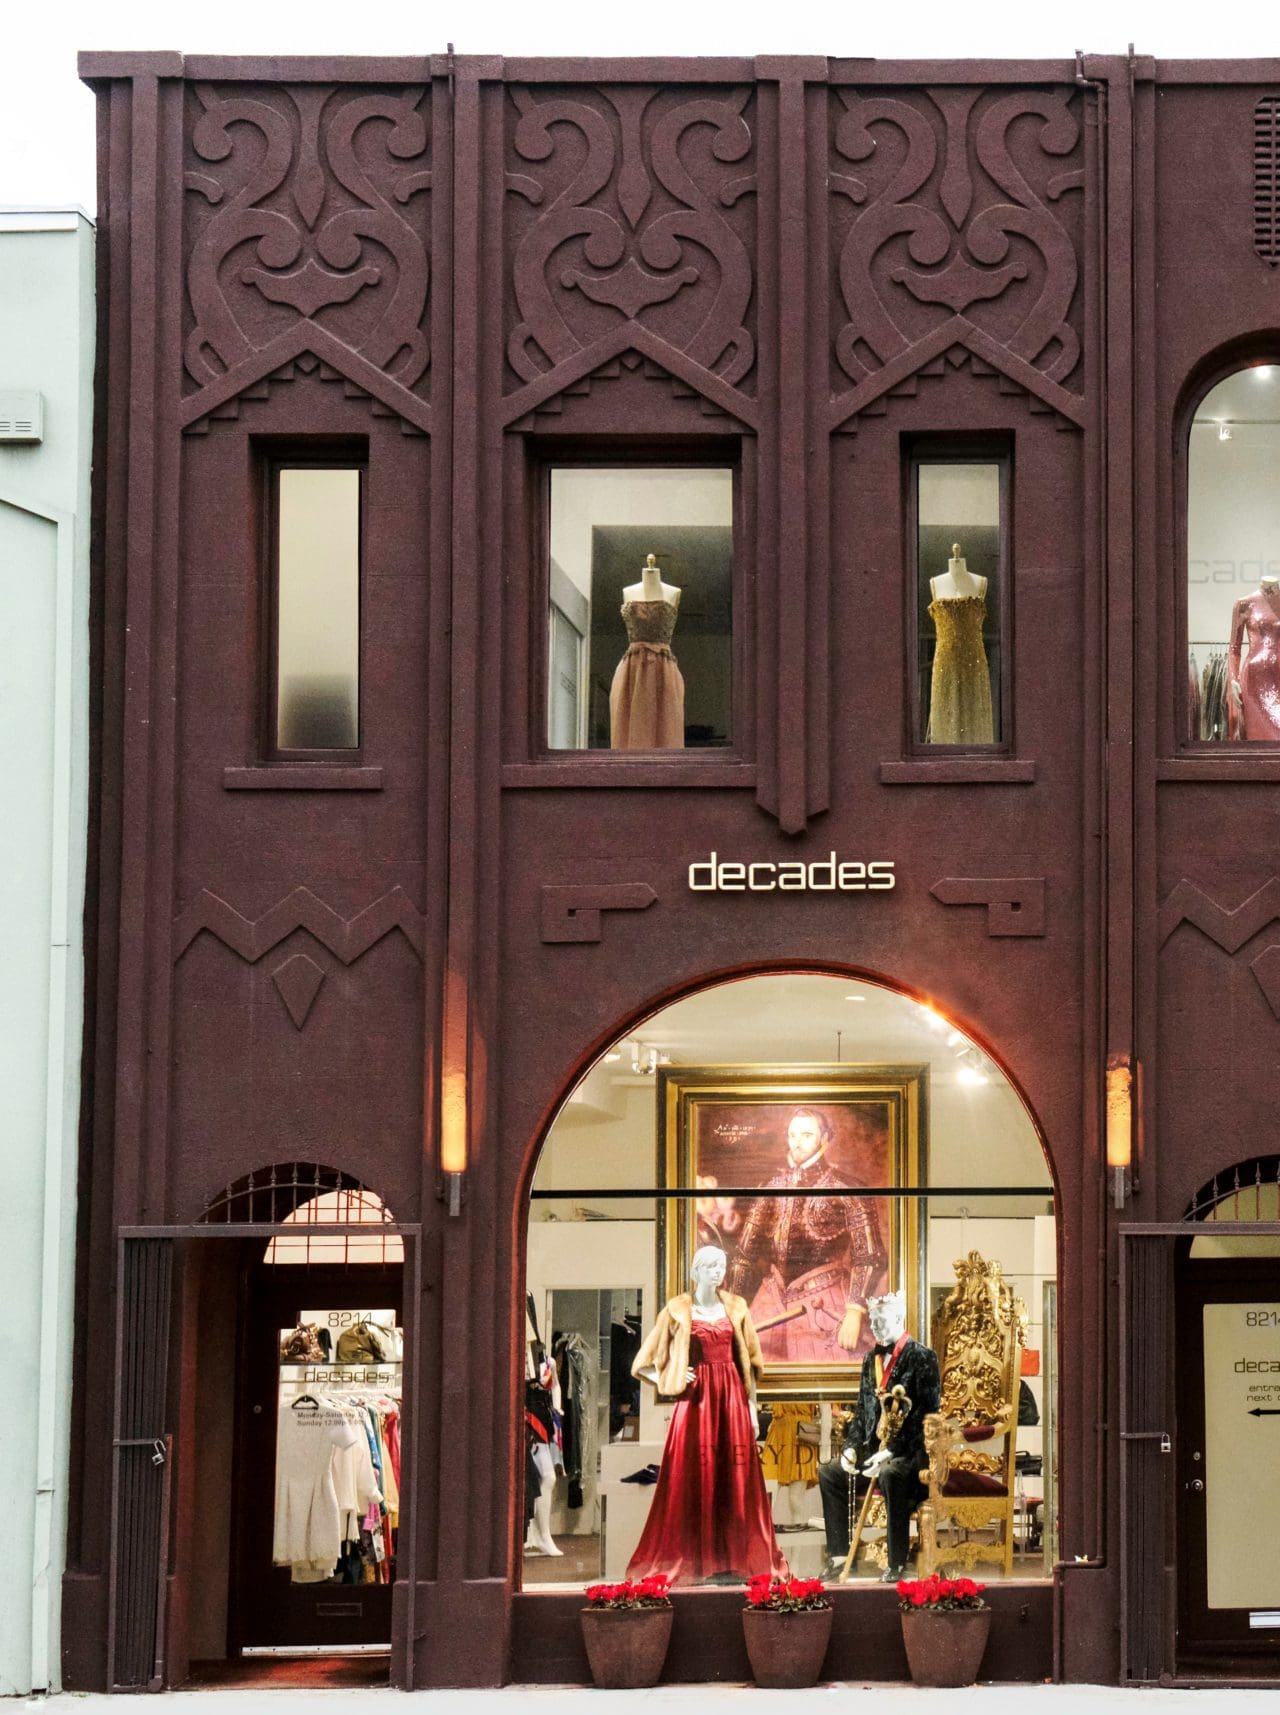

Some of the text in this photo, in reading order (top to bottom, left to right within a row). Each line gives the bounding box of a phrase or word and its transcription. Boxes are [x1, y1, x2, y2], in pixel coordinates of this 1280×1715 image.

[688, 851, 896, 891] decades
[328, 1311, 373, 1328] 8214
[304, 1367, 390, 1384] decades
[1246, 1394, 1272, 1402] next
